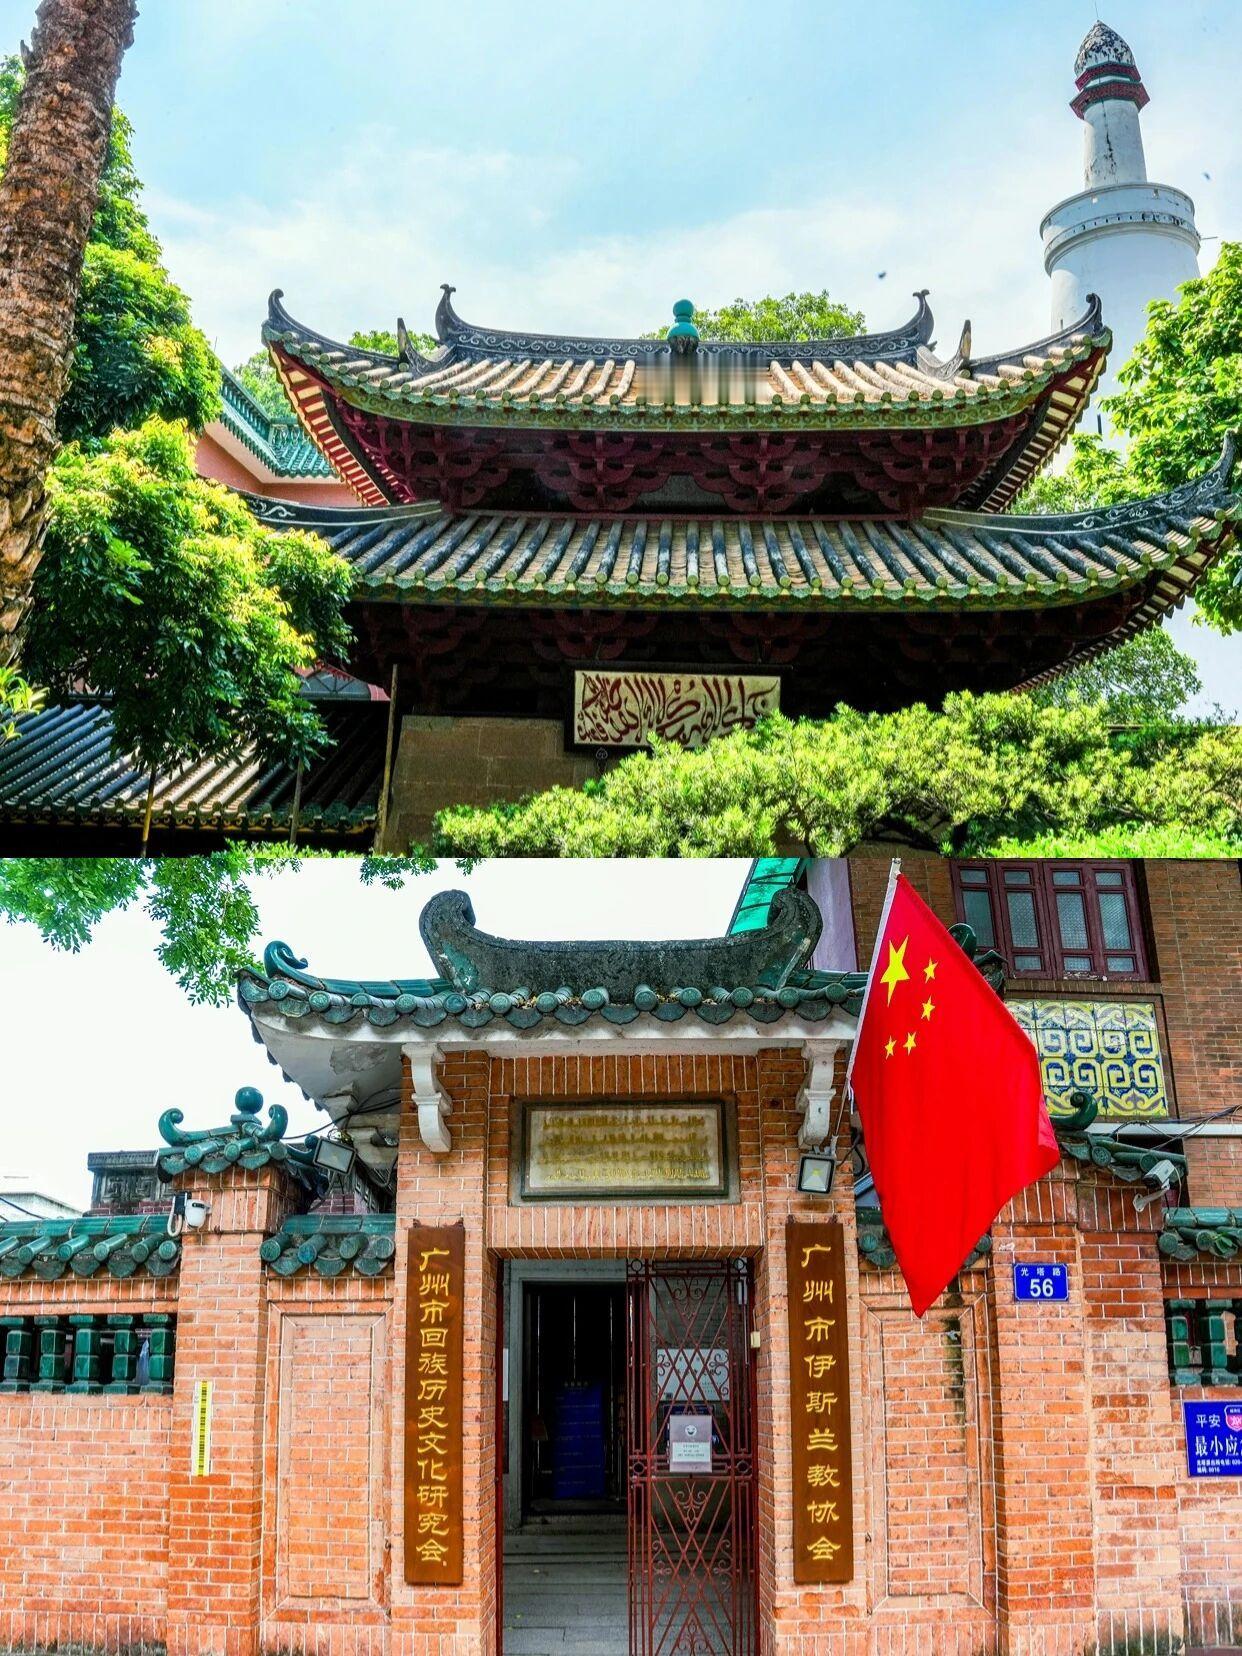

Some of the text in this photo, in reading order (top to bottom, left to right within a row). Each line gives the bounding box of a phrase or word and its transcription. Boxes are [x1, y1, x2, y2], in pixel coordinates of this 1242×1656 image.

[1020, 1267, 1061, 1277] 光塔路
[1030, 1278, 1054, 1297] 56
[416, 1247, 450, 1562] 广州市回族历史文化研究会
[801, 1243, 841, 1561] 广州市伊斯兰教协会
[1195, 1414, 1220, 1428] 平安
[1195, 1433, 1242, 1457] 最小应
